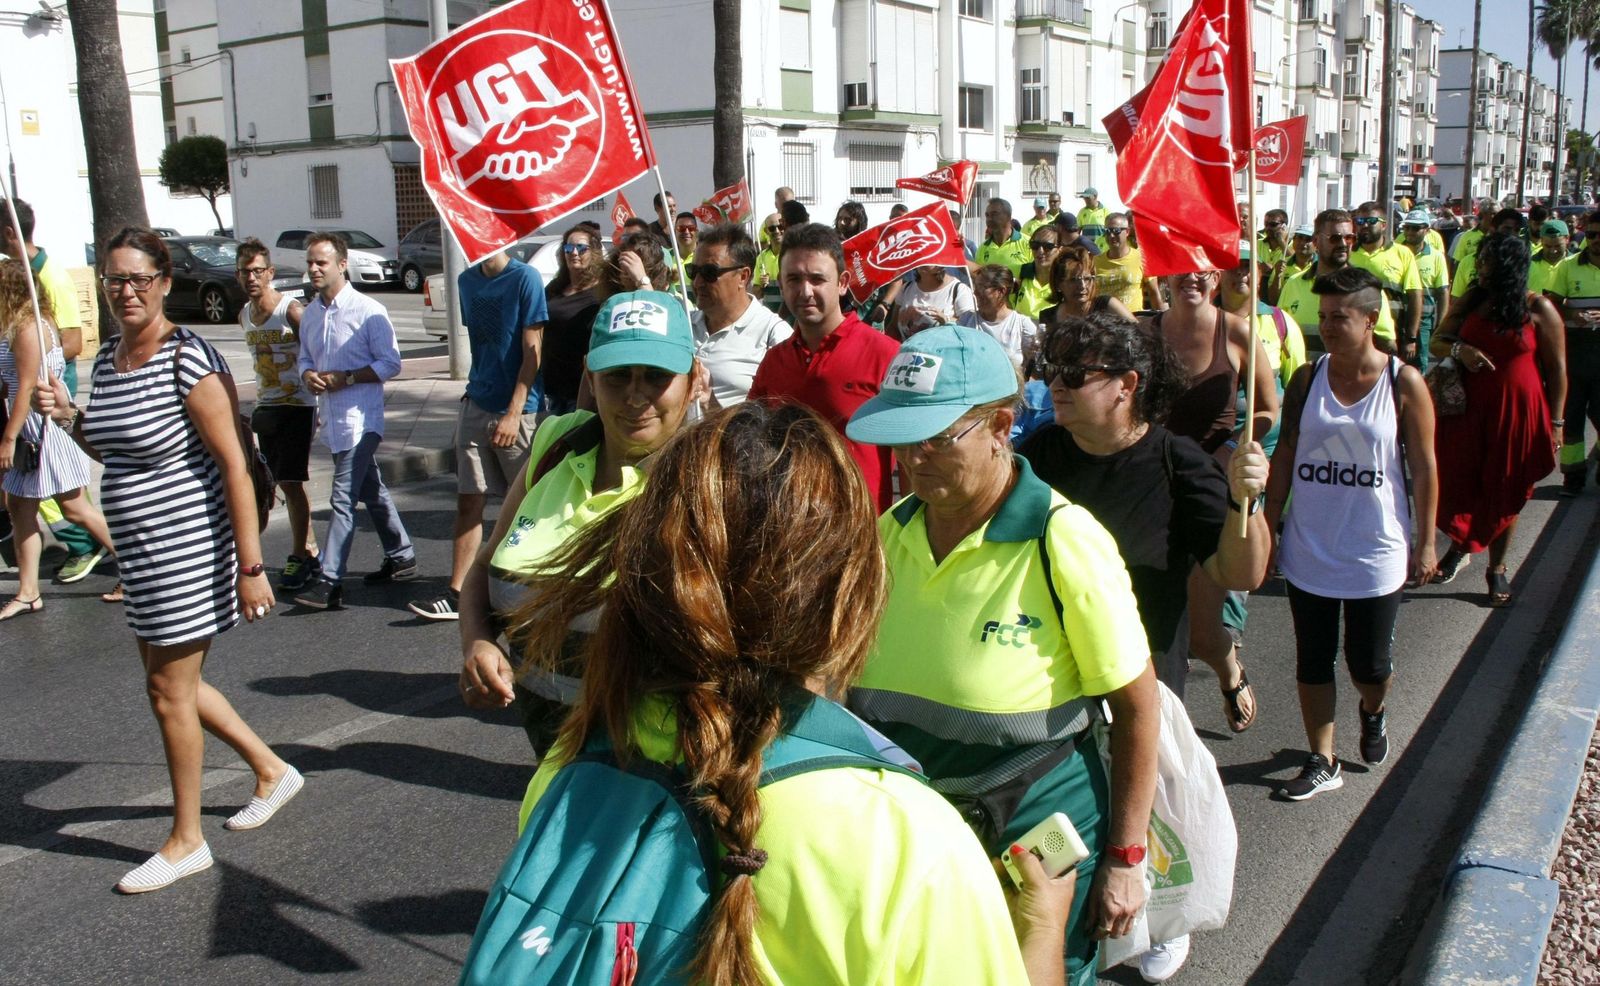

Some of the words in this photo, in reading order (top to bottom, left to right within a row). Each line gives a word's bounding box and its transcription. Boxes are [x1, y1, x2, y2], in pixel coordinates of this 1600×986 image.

[436, 45, 563, 154] UGT
[878, 219, 929, 254] UGT
[612, 309, 654, 330] FCC
[1297, 460, 1384, 488] adidas
[980, 620, 1029, 649] FCC
